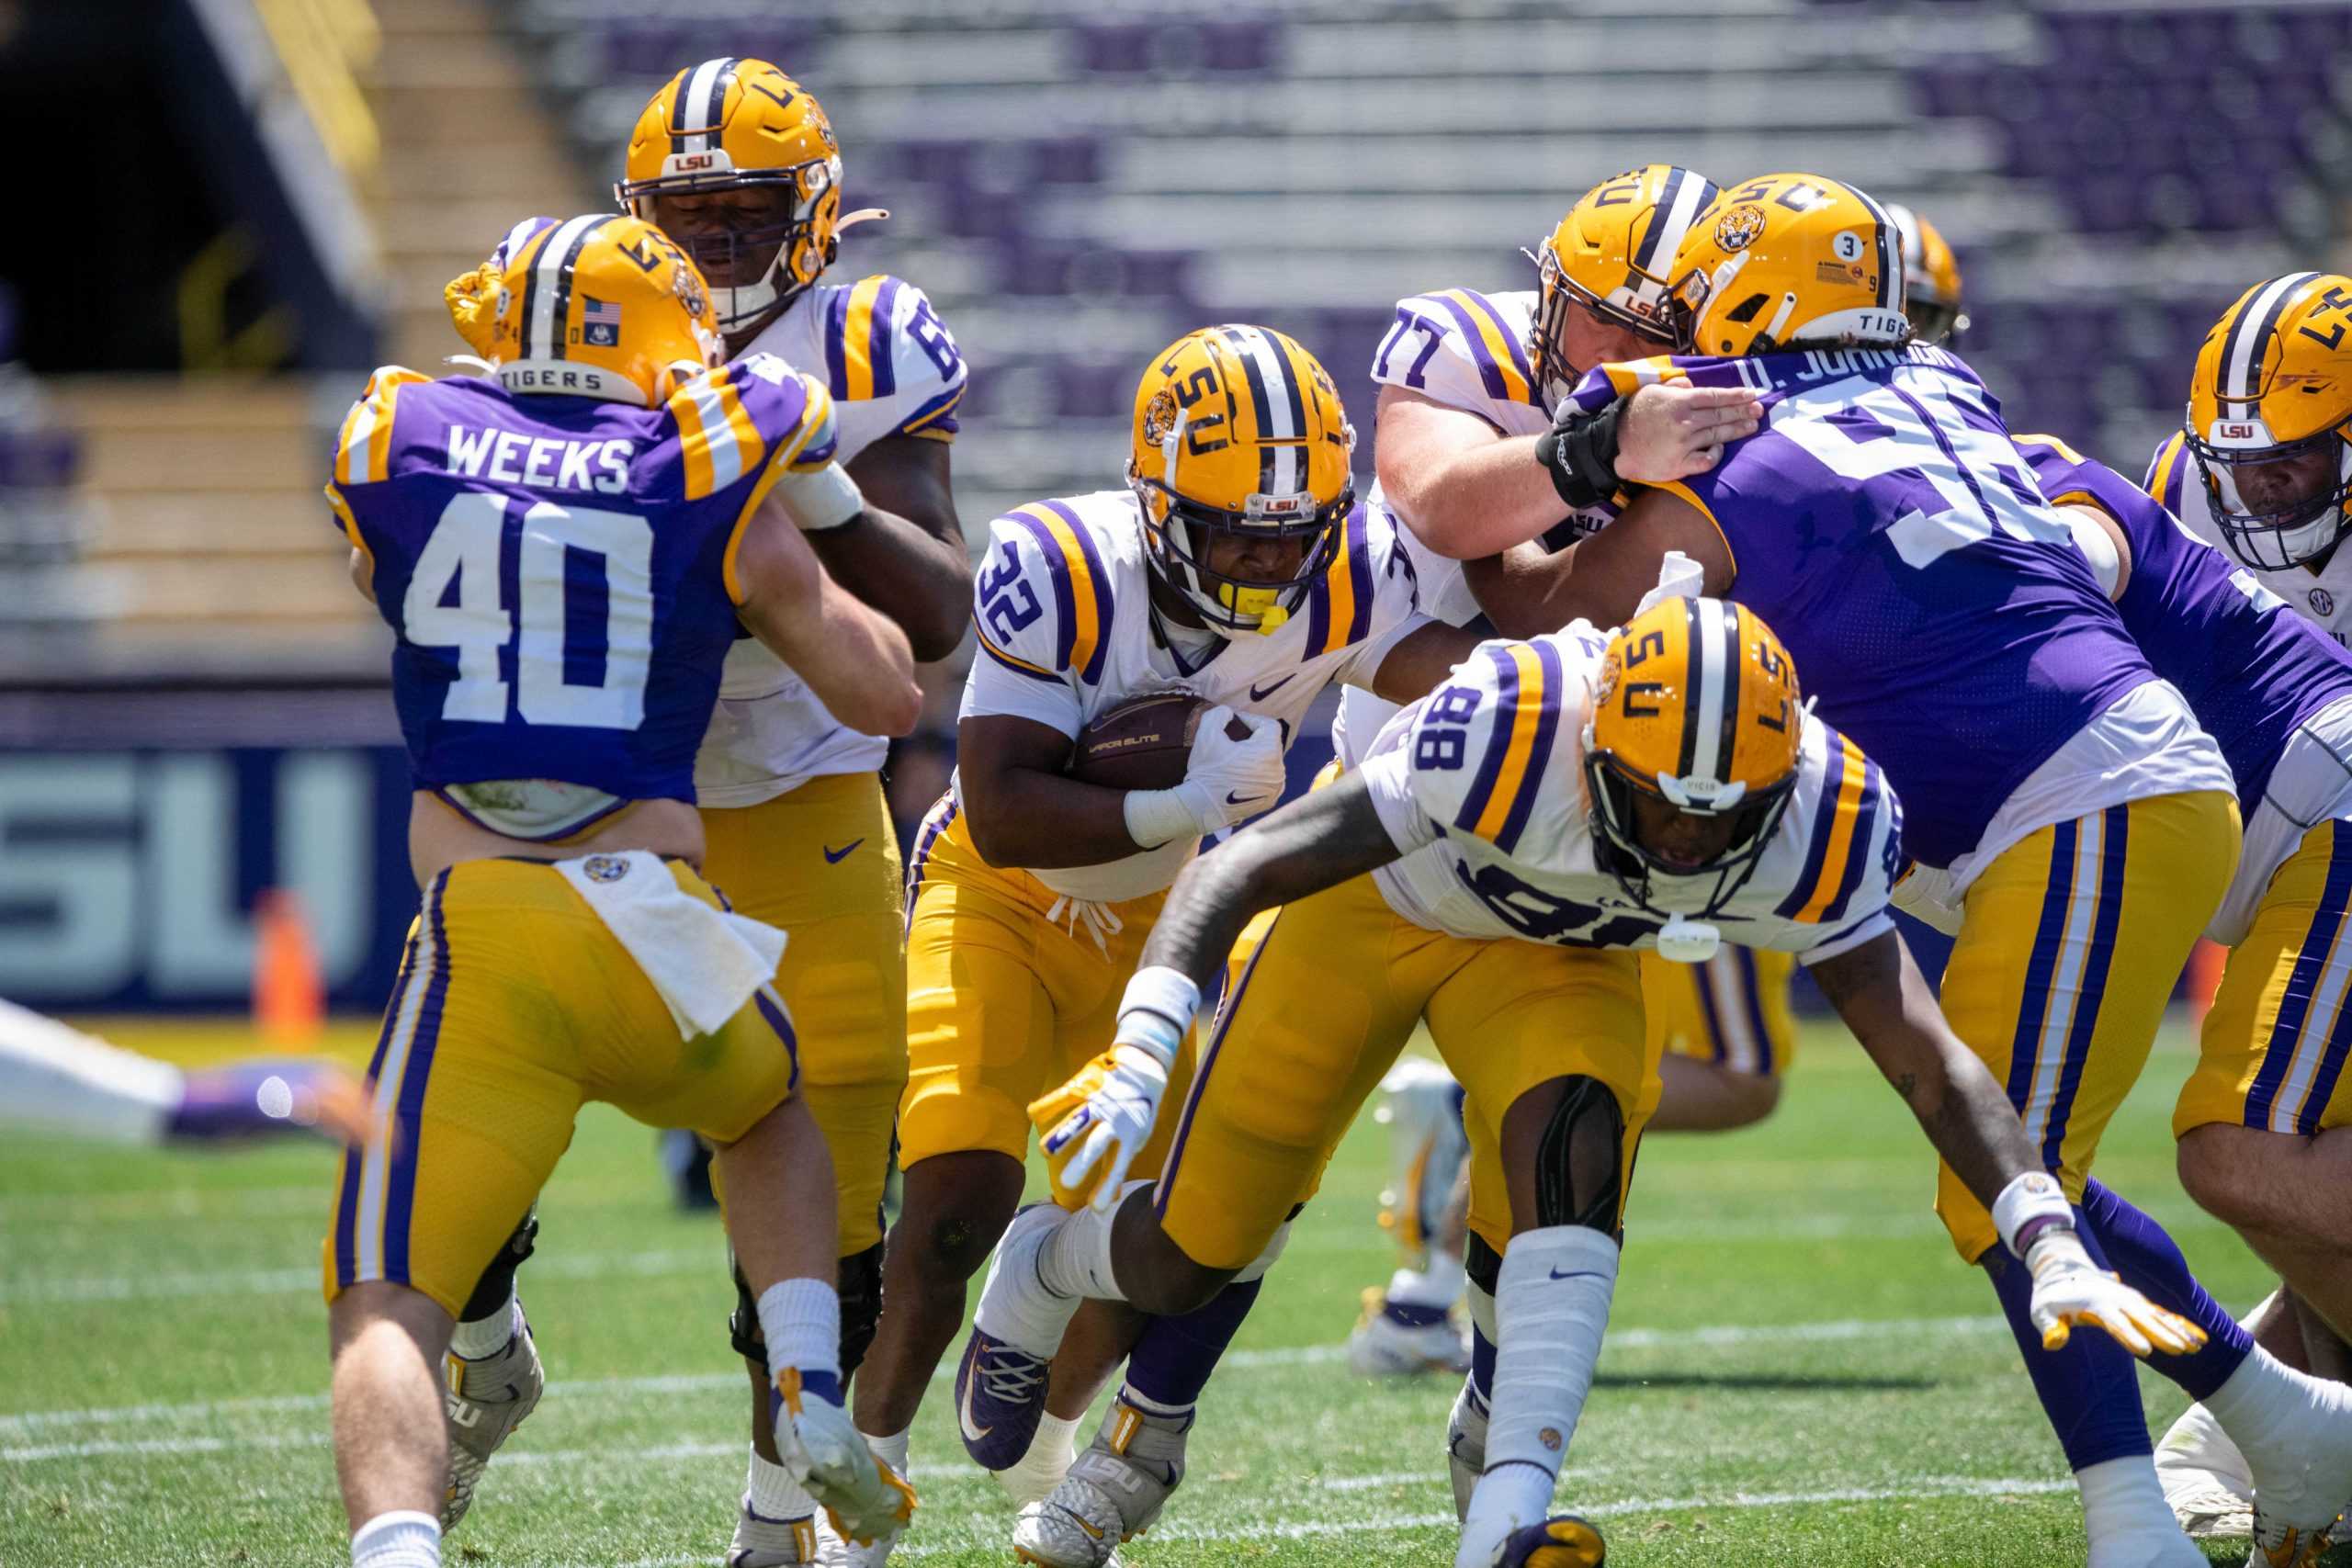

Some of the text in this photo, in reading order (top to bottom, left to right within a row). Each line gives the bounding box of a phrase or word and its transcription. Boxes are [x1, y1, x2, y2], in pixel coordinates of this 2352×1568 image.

[674, 154, 713, 172] LSU
[1843, 236, 1854, 257] 3
[1869, 275, 1877, 292] 9
[906, 298, 961, 383] 6
[500, 369, 601, 390] TIGERS
[1160, 341, 1229, 457] LSU
[2220, 423, 2254, 439] LSU
[447, 424, 636, 494] WEEKS
[1265, 499, 1298, 513] LSU
[402, 492, 654, 731] 40
[978, 540, 1044, 648] 32
[1415, 685, 1484, 772] 88
